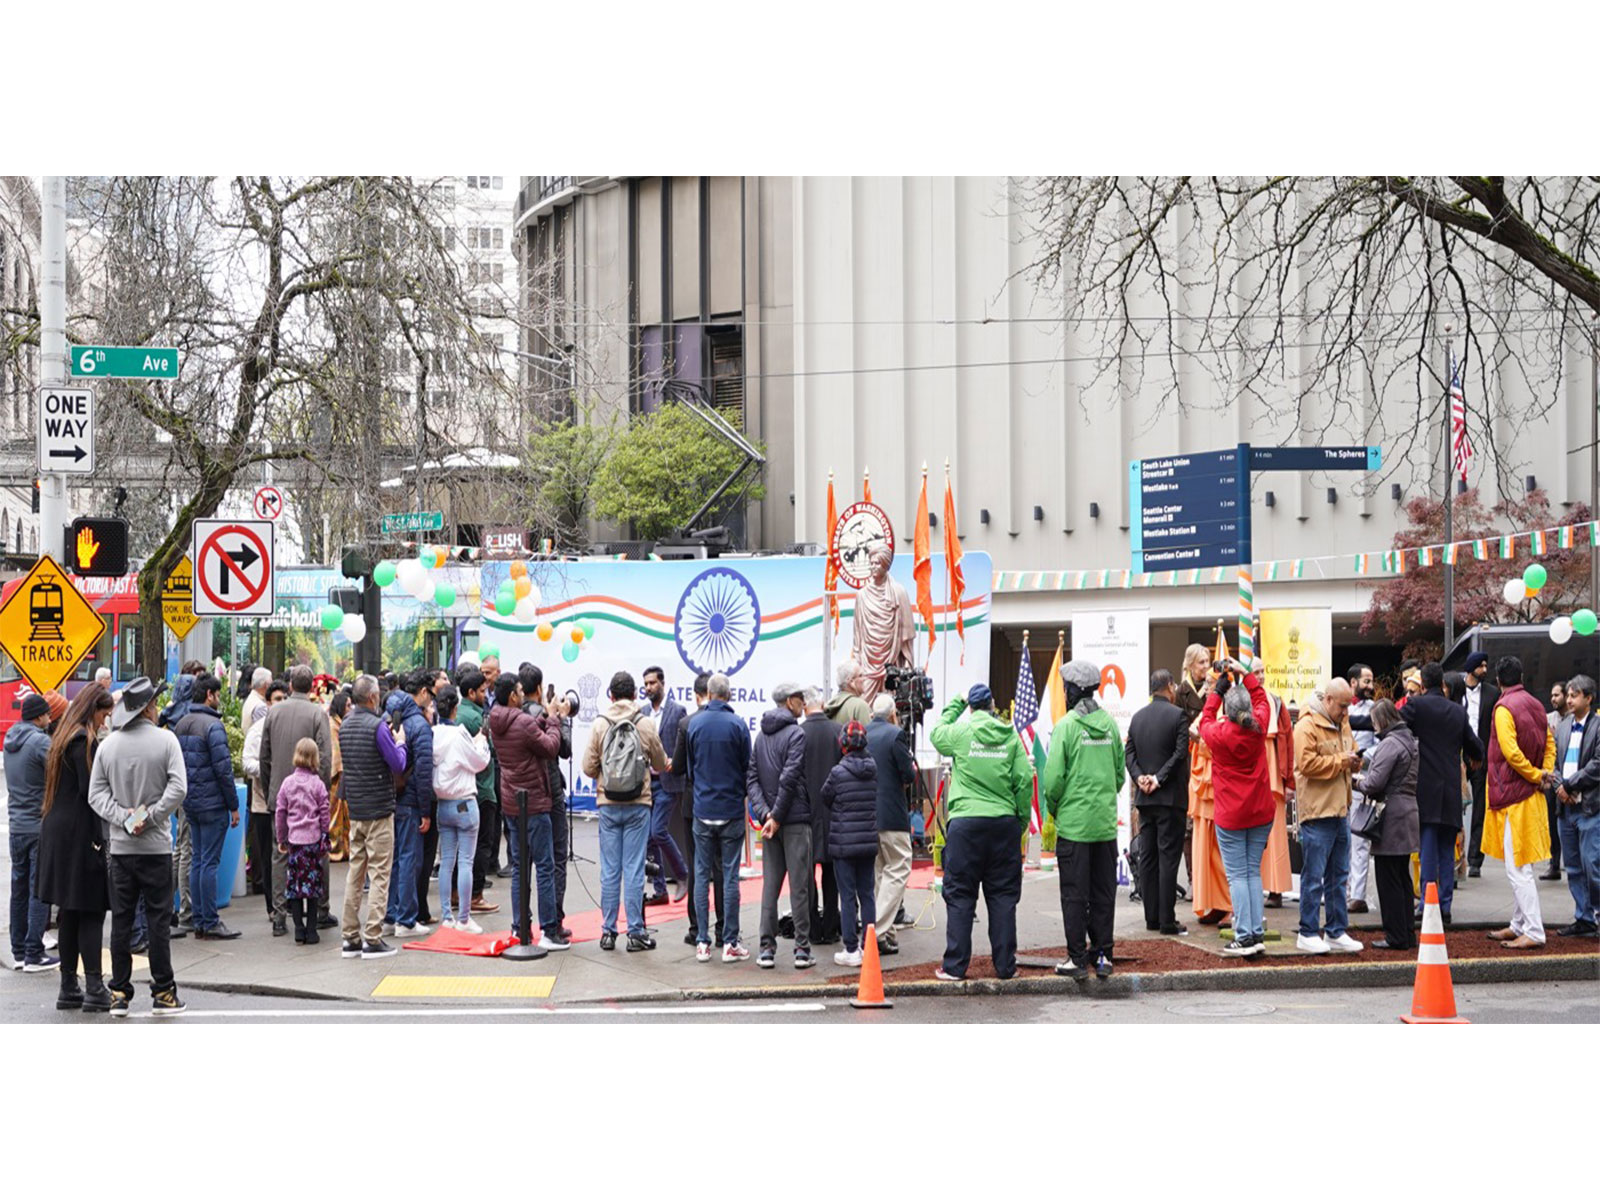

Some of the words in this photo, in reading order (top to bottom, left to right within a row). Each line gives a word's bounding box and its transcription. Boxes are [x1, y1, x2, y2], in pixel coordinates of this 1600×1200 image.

[80, 350, 106, 372] 6th
[143, 355, 169, 371] Ave
[46, 395, 87, 414] ONE
[45, 419, 88, 438] WAY
[1324, 450, 1338, 458] The
[1339, 450, 1366, 459] Spheres
[1142, 462, 1158, 470] South
[1160, 460, 1172, 468] Lake
[1142, 470, 1168, 479] Streetcar
[1143, 484, 1168, 493] Westlake
[1143, 506, 1163, 515] Seattle
[1163, 505, 1183, 513] Center
[844, 507, 854, 519] OF
[855, 503, 892, 545] WASHINGTON
[1143, 515, 1168, 524] Monorail
[1143, 529, 1169, 538] Westlake
[1169, 527, 1190, 536] Station
[1144, 552, 1175, 561] Convention
[1175, 550, 1194, 558] Center
[75, 577, 109, 594] VICTORIA
[277, 576, 318, 594] HISTORIC
[163, 605, 178, 613] OOK
[183, 605, 193, 614] BO
[171, 615, 191, 624] WAYS
[21, 645, 73, 662] TRACKS
[1265, 664, 1296, 674] Consulate
[1297, 664, 1322, 675] General
[1269, 679, 1276, 688] of
